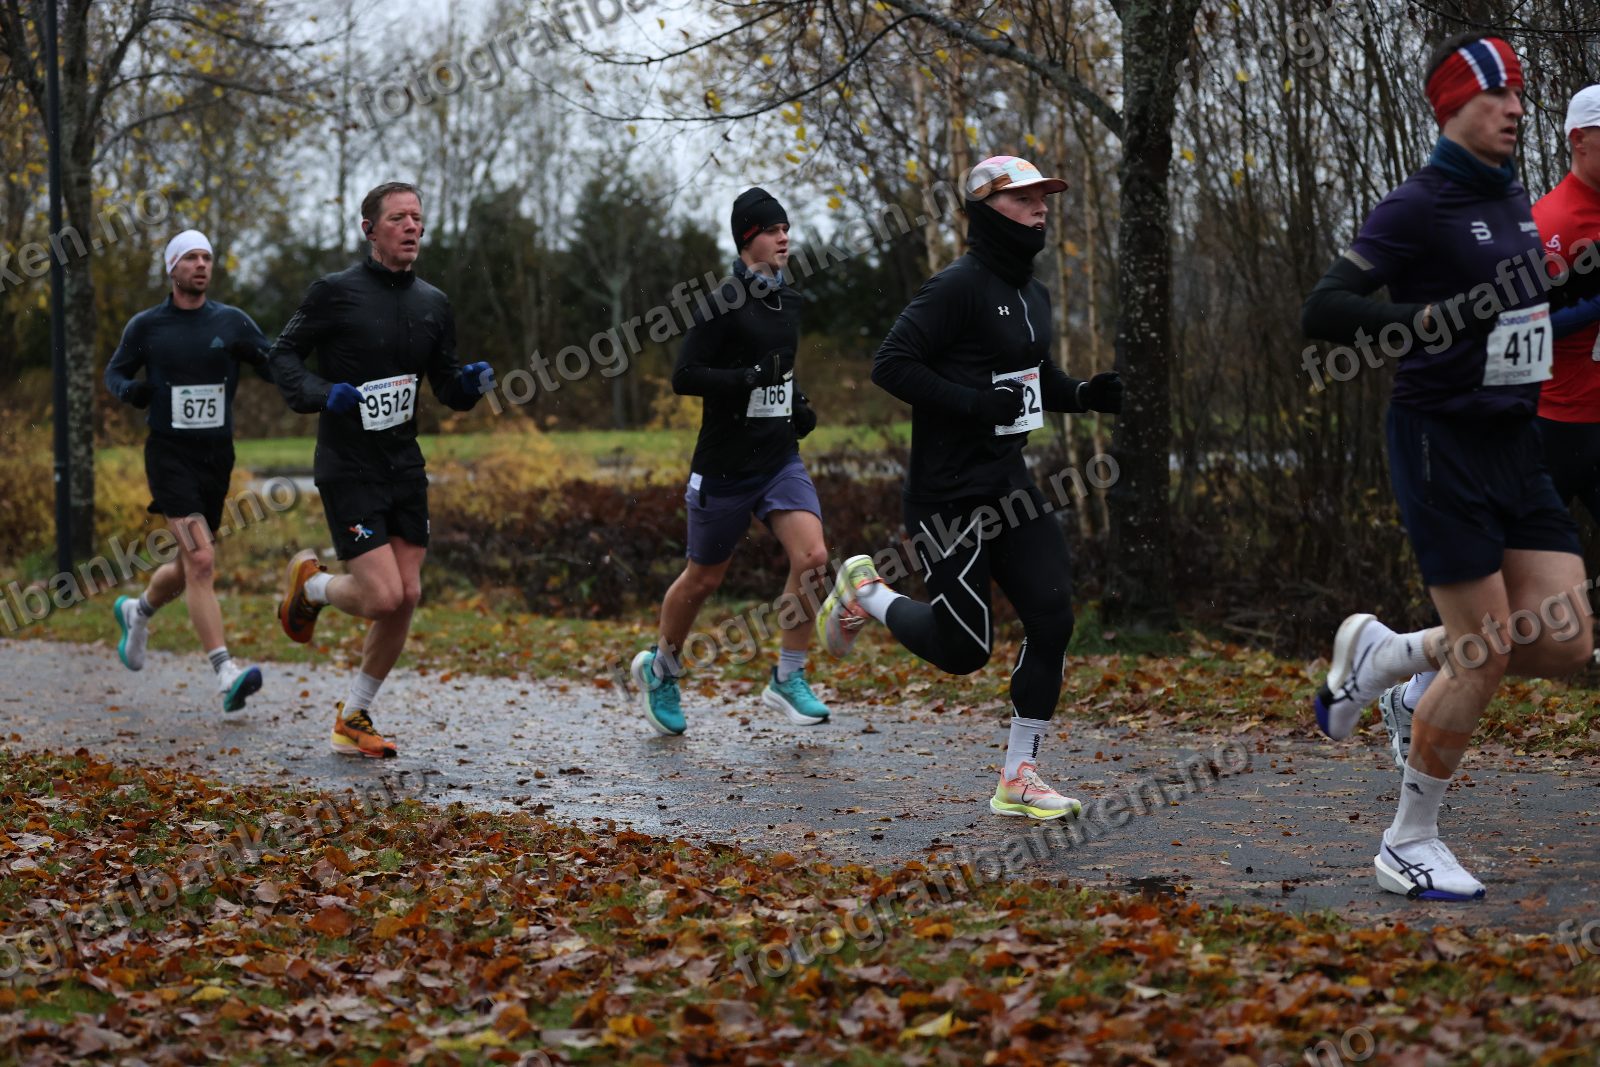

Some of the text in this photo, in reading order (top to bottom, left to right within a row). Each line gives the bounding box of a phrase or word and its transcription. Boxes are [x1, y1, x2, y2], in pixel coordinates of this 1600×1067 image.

[1504, 326, 1545, 366] 417
[184, 398, 216, 419] 675
[366, 387, 411, 418] 9512
